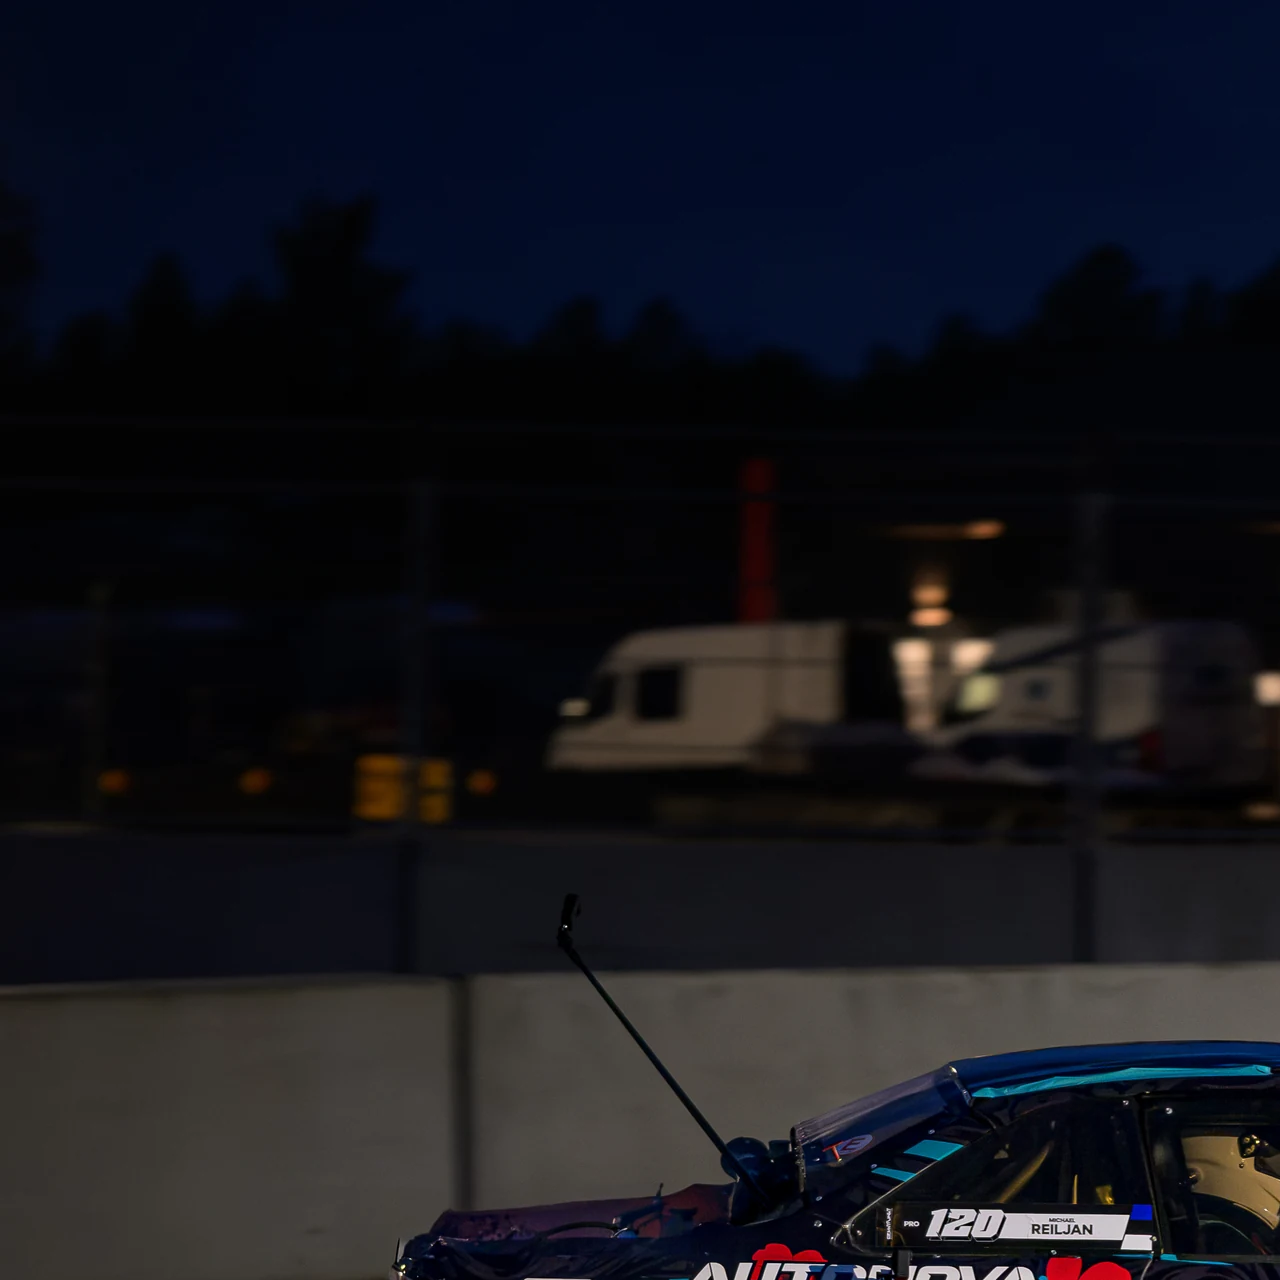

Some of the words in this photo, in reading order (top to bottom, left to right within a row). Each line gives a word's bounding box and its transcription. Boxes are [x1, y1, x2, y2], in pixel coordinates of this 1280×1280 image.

[903, 1220, 920, 1228] PRO
[925, 1208, 1007, 1242] 120
[1031, 1224, 1093, 1235] REILJAN
